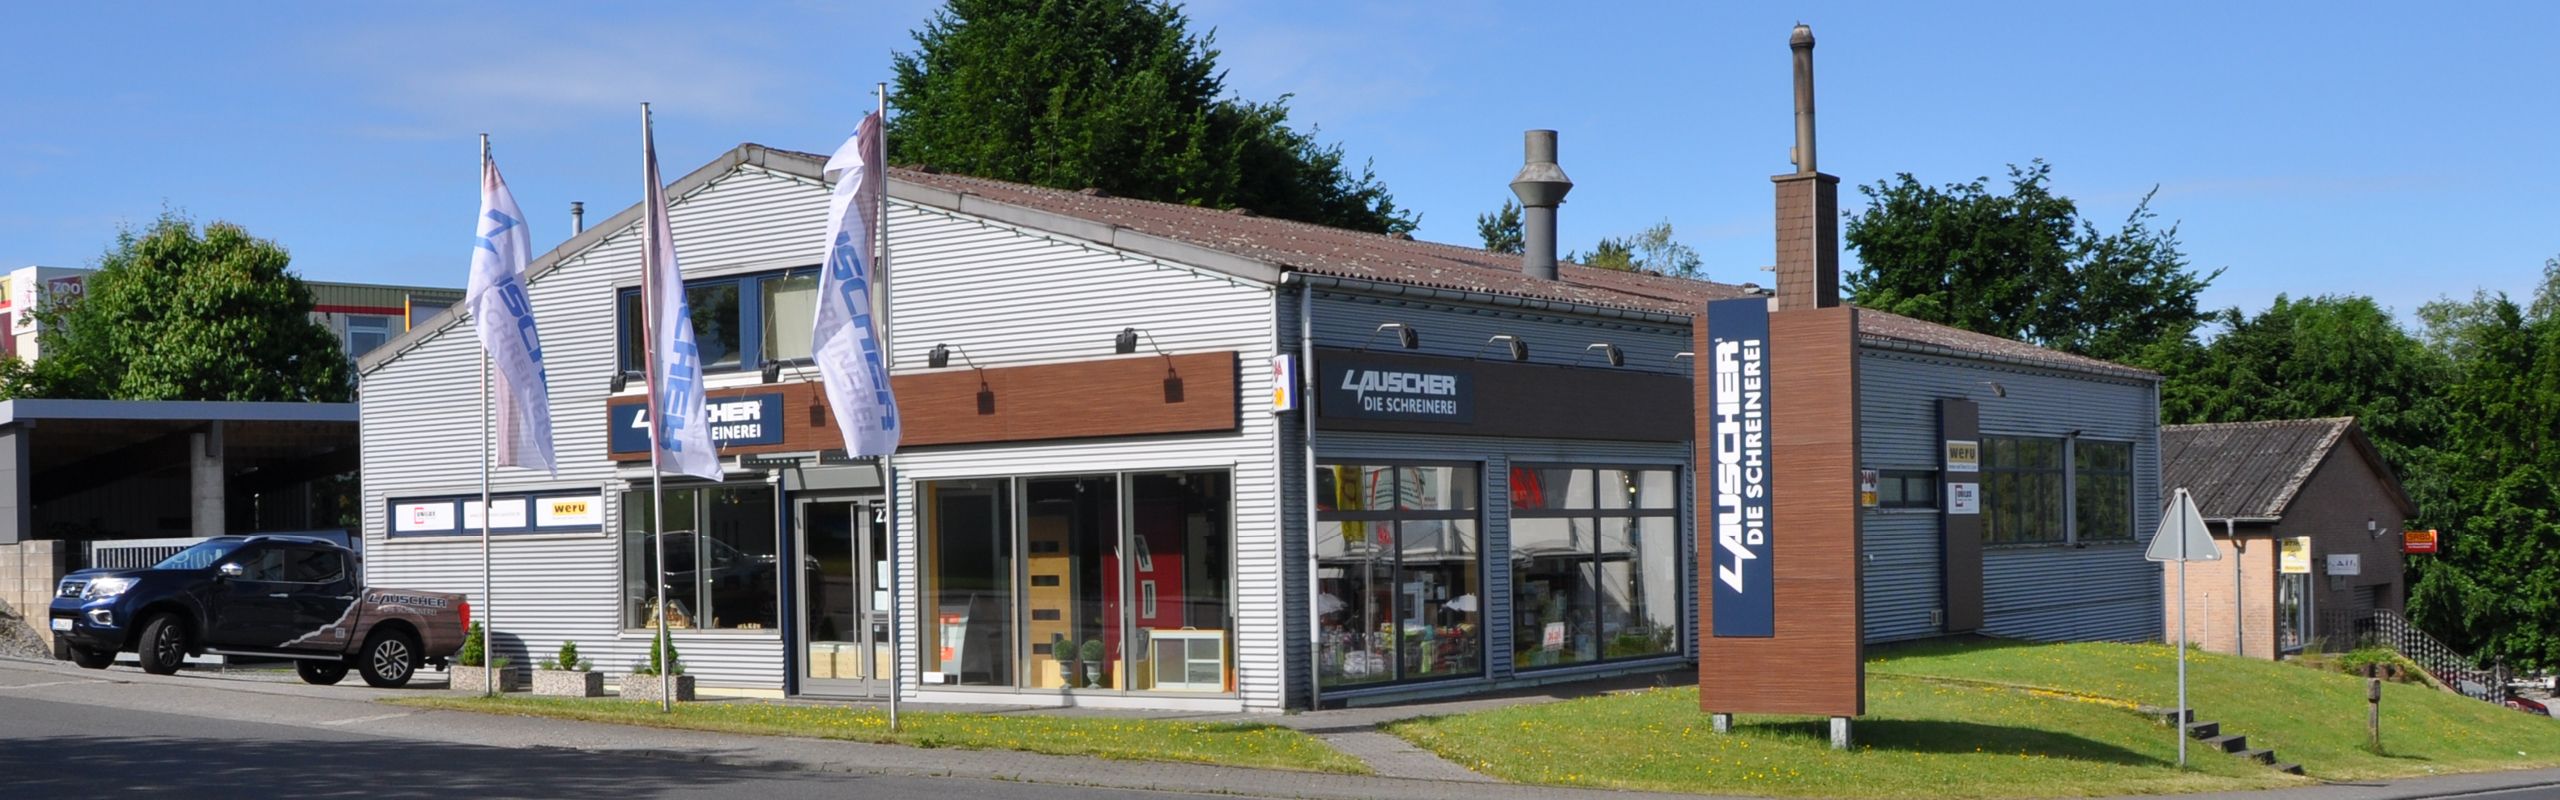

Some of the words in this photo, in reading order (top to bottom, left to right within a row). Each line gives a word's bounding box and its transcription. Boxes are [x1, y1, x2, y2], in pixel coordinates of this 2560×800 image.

[53, 281, 81, 295] ZOO
[1341, 369, 1456, 404] LAUSCHER
[1364, 396, 1383, 412] DIE
[1386, 397, 1457, 415] SCHREINEREI
[1743, 339, 1764, 498] SCHREINEREI
[711, 423, 761, 440] EINEREI
[1949, 447, 1976, 459] weru
[1716, 340, 1757, 594] LAUSCHER
[554, 503, 586, 514] weru
[1746, 506, 1764, 545] DIE
[367, 593, 447, 608] LAUSCHER
